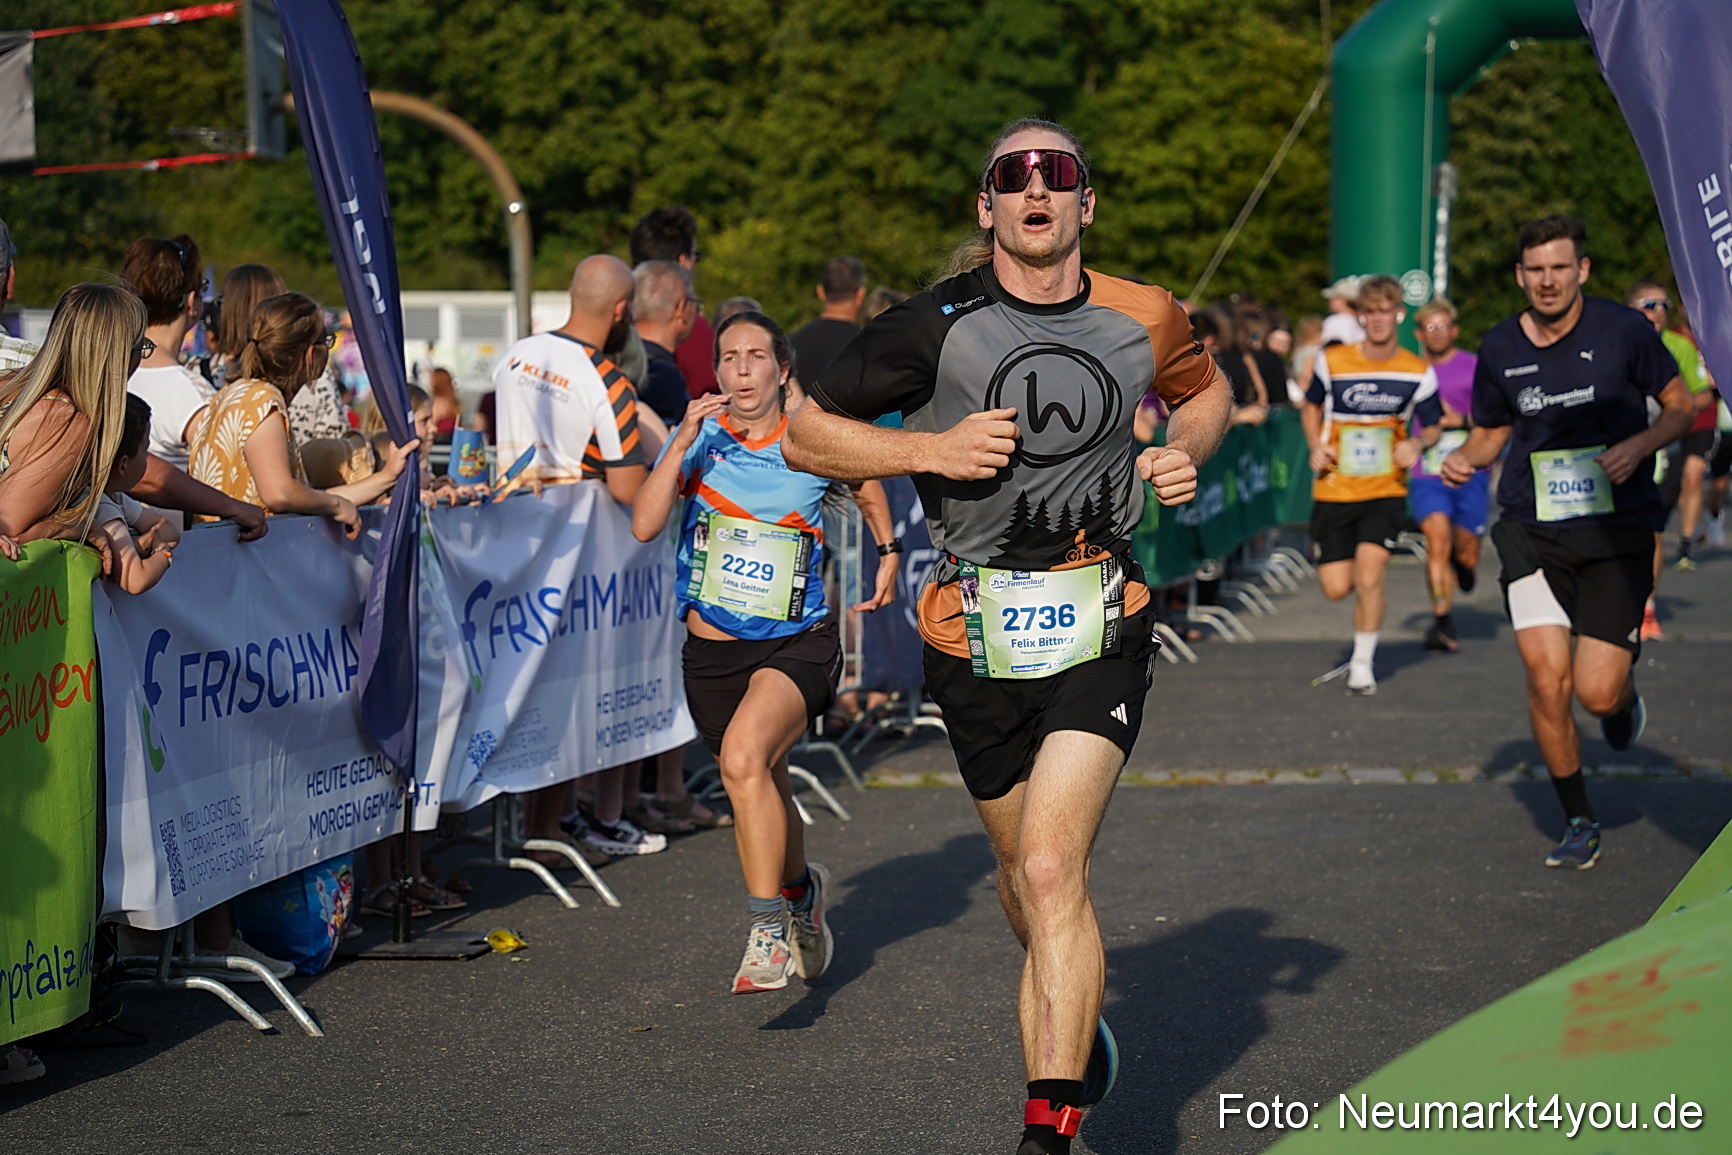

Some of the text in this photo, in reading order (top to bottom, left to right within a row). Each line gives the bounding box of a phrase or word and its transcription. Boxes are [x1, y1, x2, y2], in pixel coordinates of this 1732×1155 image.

[1548, 477, 1594, 495] 2043
[721, 554, 774, 581] 2229
[1007, 577, 1045, 587] Firmenlauf
[722, 577, 739, 588] Lena
[740, 582, 769, 594] Geitner
[0, 585, 66, 647] irmen
[1002, 603, 1076, 631] 2736
[1011, 636, 1075, 648] Felix Bittner
[1105, 621, 1114, 649] HILTL
[179, 621, 362, 728] FRISCHMA
[306, 754, 396, 798] HEUTE GEDAC
[200, 795, 242, 827] LOGISTICS
[309, 782, 439, 839] MORGEN GEMACT.
[184, 817, 250, 861] CORPORATE PRINT
[188, 838, 265, 887] CORPORATE SIGNAGE
